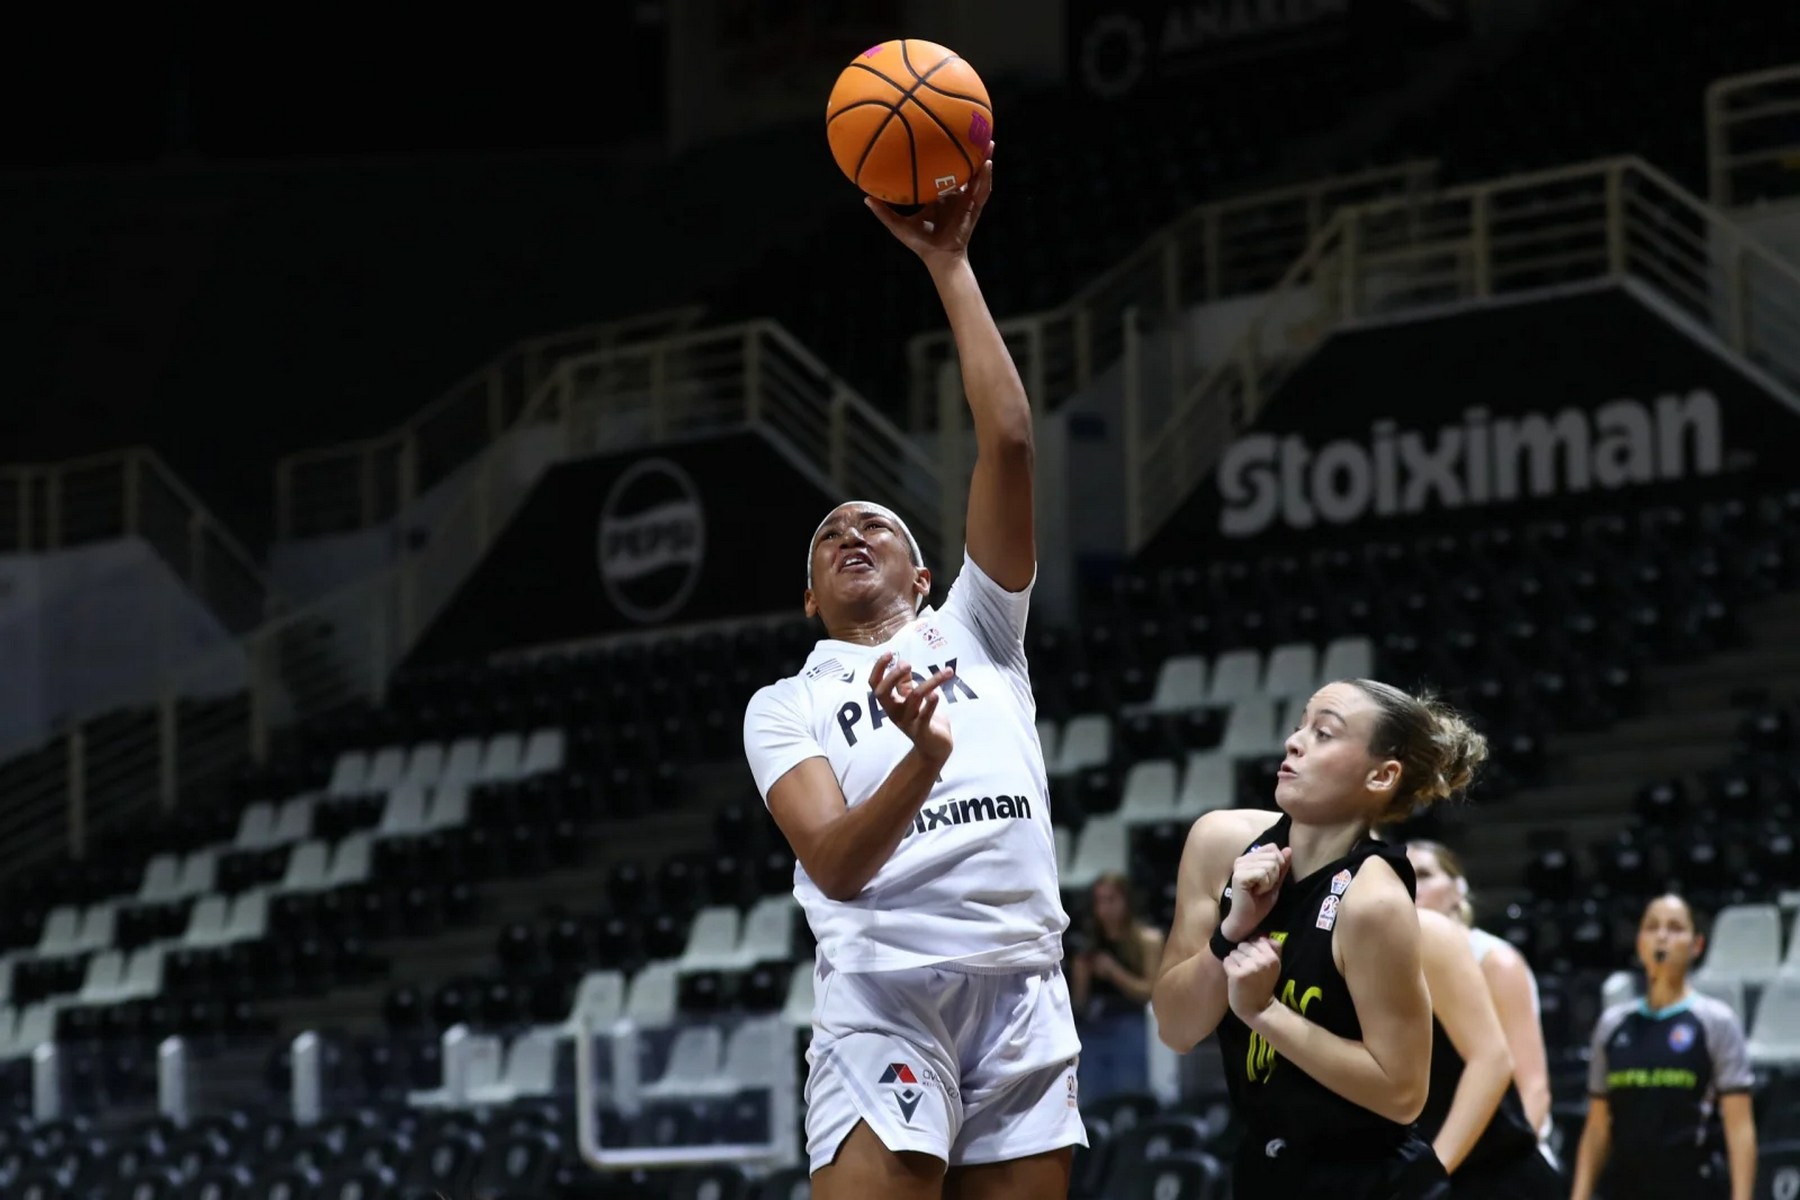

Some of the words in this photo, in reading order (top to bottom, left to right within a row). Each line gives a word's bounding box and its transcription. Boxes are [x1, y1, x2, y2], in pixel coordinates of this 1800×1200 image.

[1217, 389, 1722, 538] Stoiximan
[606, 516, 698, 562] PEPSI
[836, 657, 979, 748] PAK
[903, 795, 1032, 839] iximan
